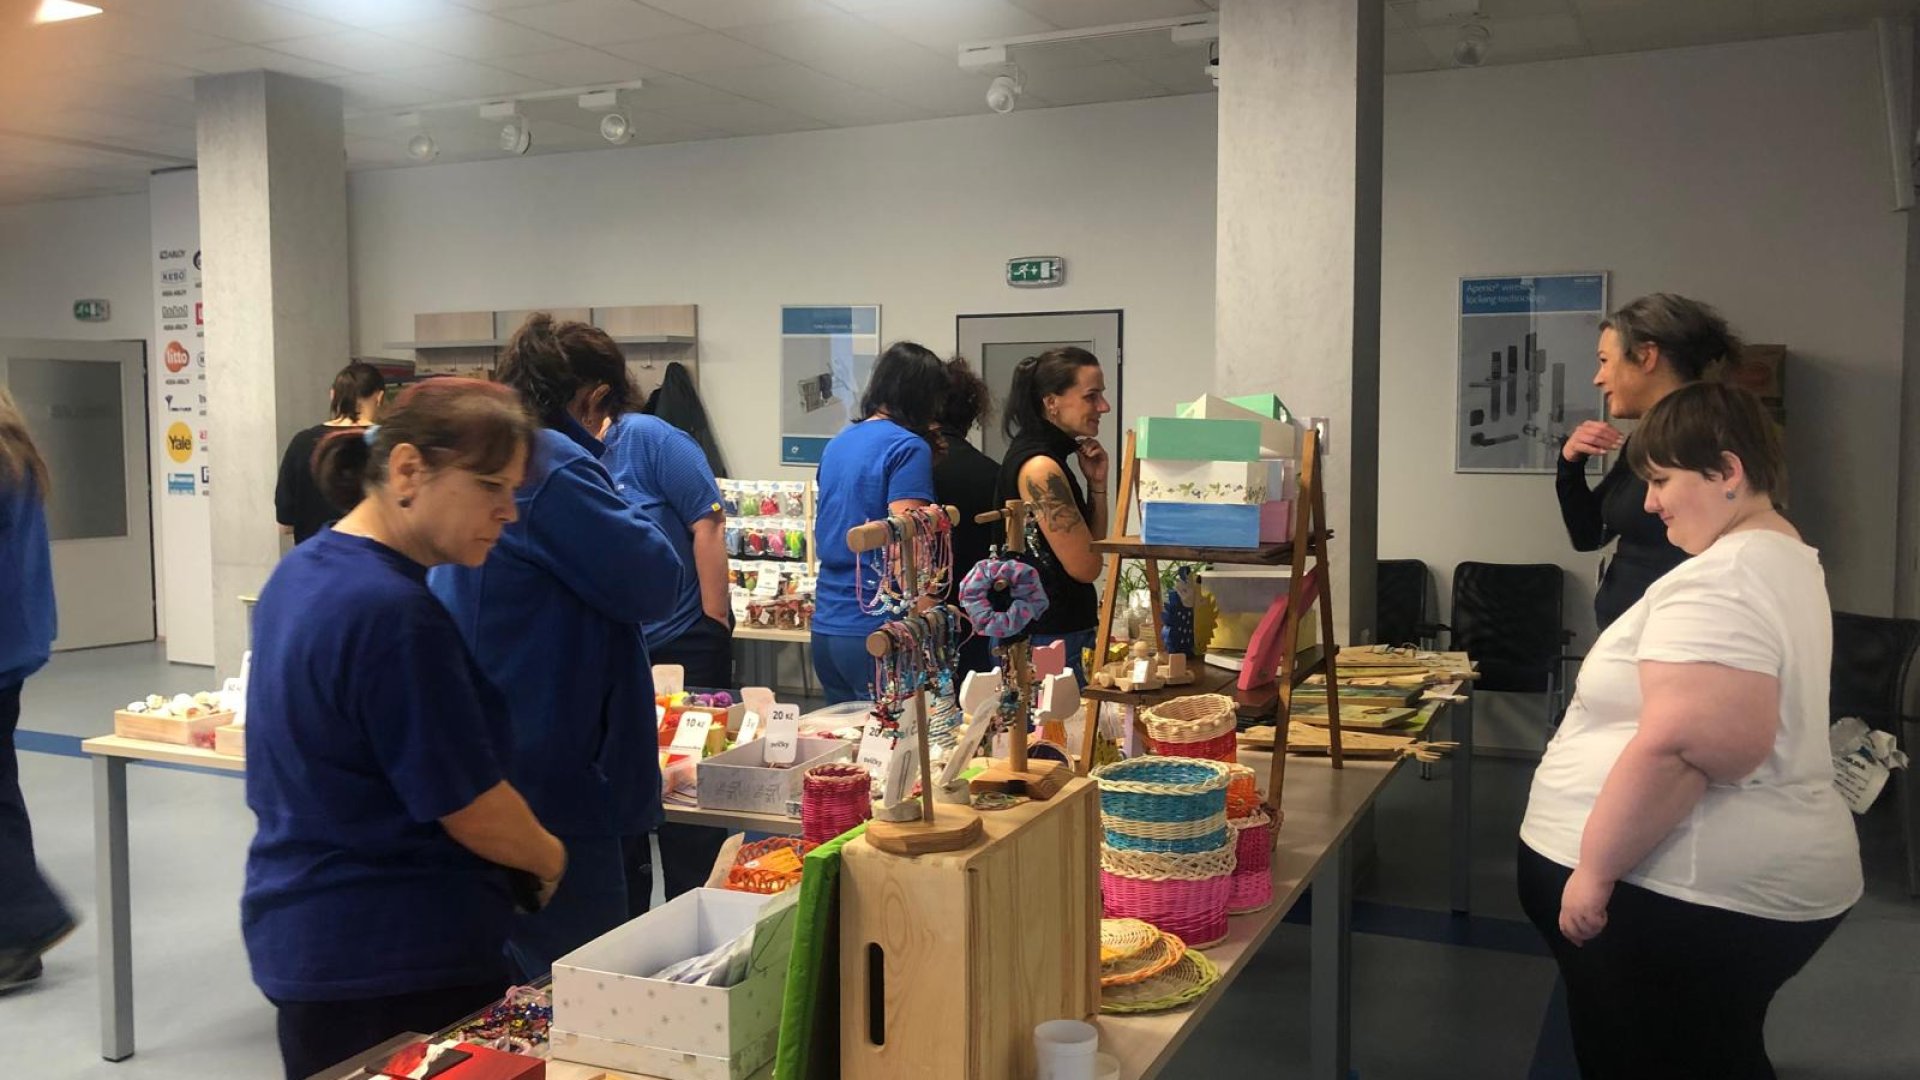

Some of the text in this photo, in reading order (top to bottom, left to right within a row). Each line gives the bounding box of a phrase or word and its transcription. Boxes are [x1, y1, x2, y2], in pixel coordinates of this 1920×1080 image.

[168, 435, 192, 450] Yale
[773, 710, 784, 720] 20
[686, 718, 696, 727] 10
[869, 726, 880, 737] 20
